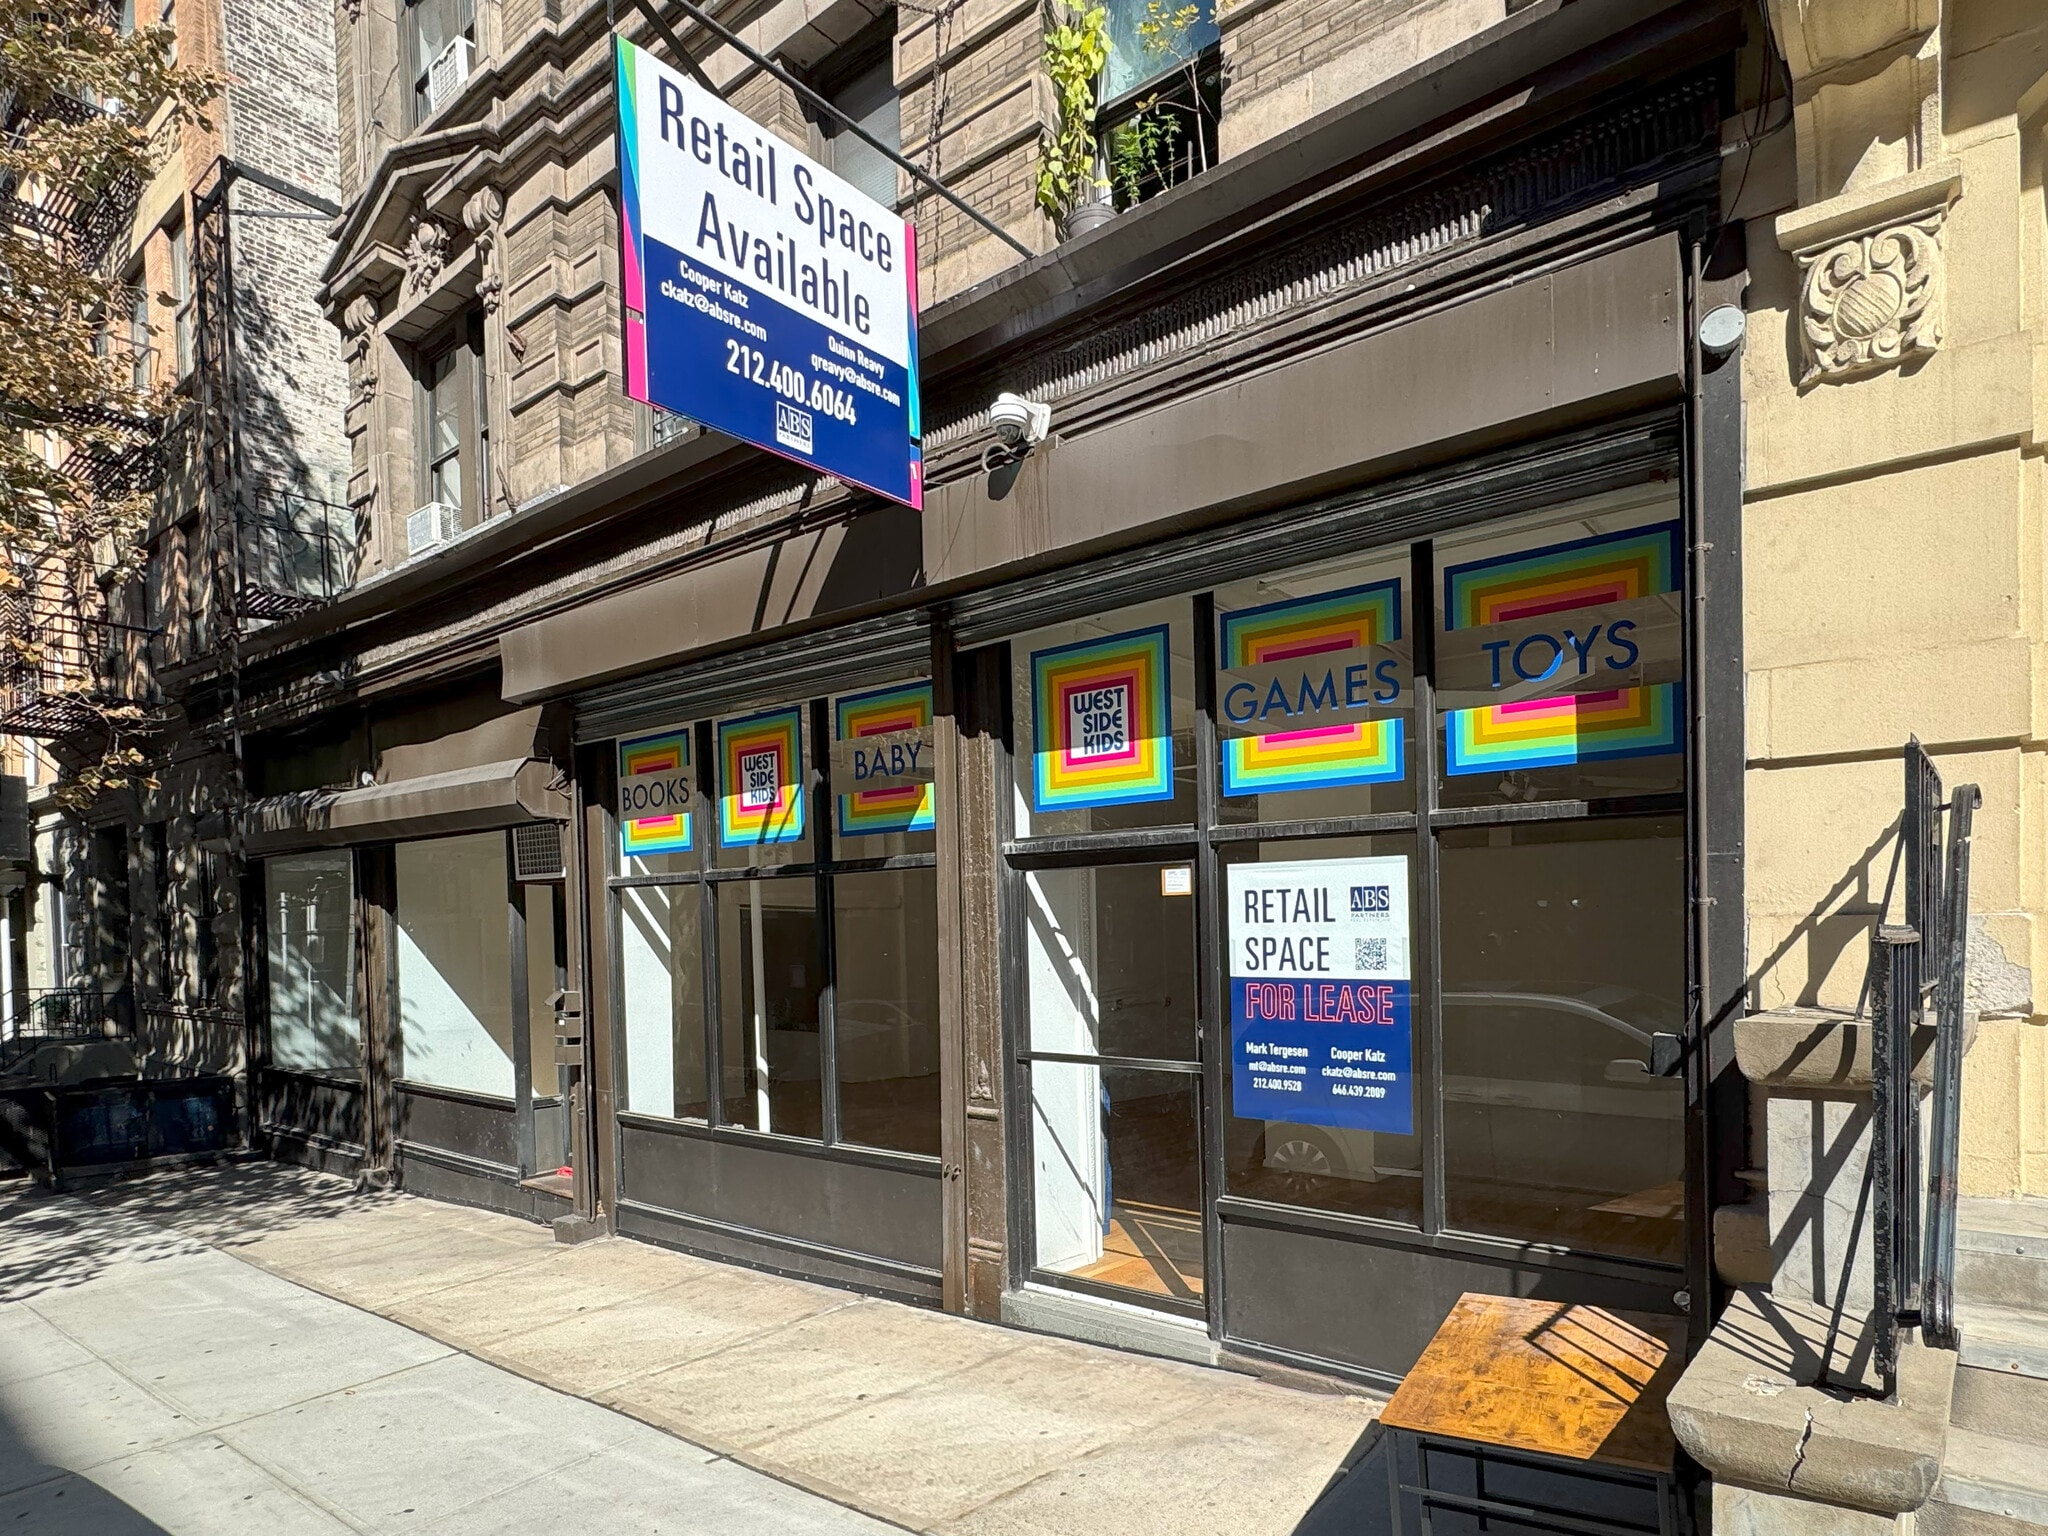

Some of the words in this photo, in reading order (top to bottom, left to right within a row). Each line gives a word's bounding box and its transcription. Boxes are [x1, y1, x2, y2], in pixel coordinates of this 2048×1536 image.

[658, 74, 778, 207] Retail
[793, 163, 894, 274] Space
[696, 190, 871, 336] Available
[679, 260, 722, 293] Cooper
[723, 281, 749, 309] Katz
[660, 279, 768, 342] ckatz@absre.com
[828, 335, 856, 363] Quinn
[857, 350, 885, 380] Reavy
[726, 339, 857, 426] 212.400.6064
[811, 353, 901, 408] qreavy@absre.com
[779, 408, 811, 438] ABS
[1481, 619, 1639, 688] TOYS
[1073, 686, 1124, 714] WEST
[1223, 659, 1400, 725] GAMES
[1082, 709, 1123, 733] SIDE
[854, 740, 922, 781] BABY
[1083, 730, 1124, 755] KIDS
[744, 752, 775, 773] WEST
[750, 767, 775, 786] SIDE
[622, 776, 690, 812] BOOKS
[750, 785, 775, 804] KIDS
[1244, 887, 1336, 924] RETAIL
[1351, 888, 1389, 909] ABS
[1245, 936, 1331, 972] SPACE
[1245, 983, 1295, 1021] FOR
[1304, 984, 1395, 1025] LEASE
[1245, 1041, 1268, 1055] Mark
[1268, 1043, 1309, 1059] Tergesen
[1248, 1061, 1307, 1075] mt@absre.com
[1330, 1047, 1363, 1063] Cooper
[1365, 1049, 1386, 1062] Katz
[1321, 1066, 1397, 1081] ckatz@absre.com
[1332, 1084, 1386, 1099] 646.439.2009
